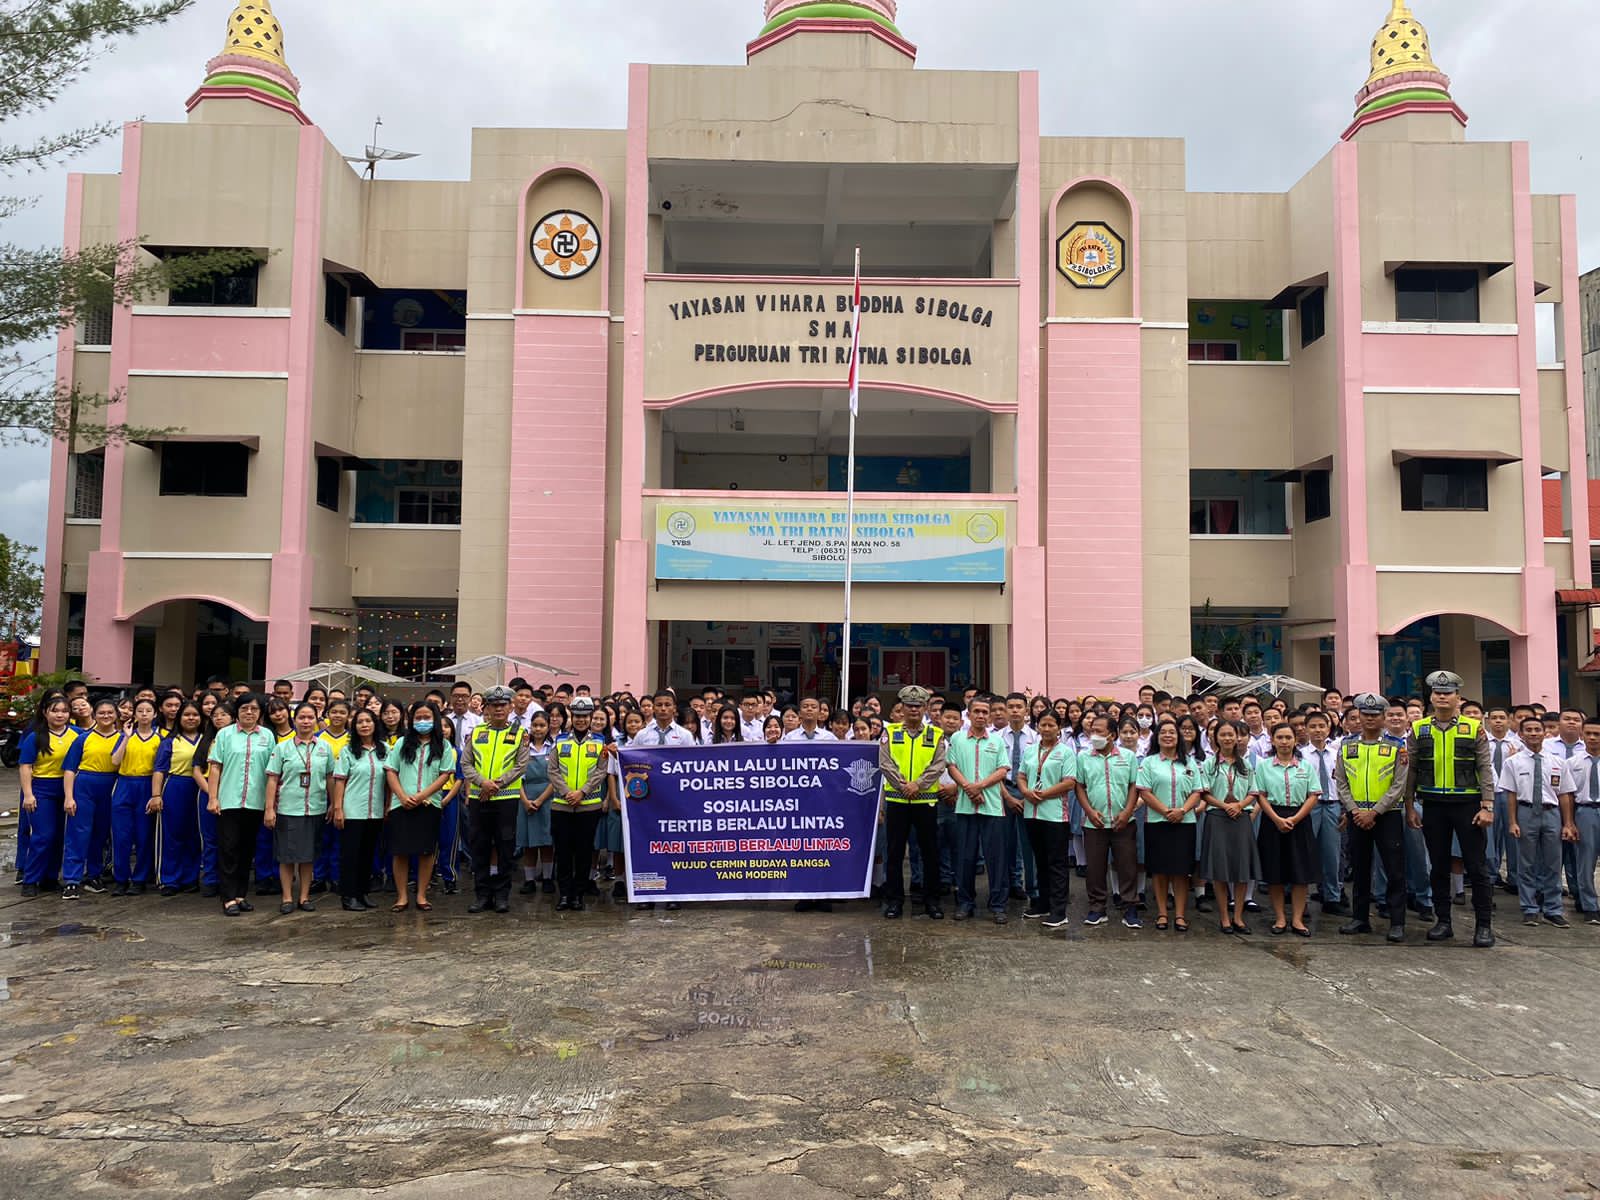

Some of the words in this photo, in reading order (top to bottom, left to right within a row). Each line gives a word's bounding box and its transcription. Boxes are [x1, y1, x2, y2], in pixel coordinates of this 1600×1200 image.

[1078, 265, 1106, 275] SIBOLGA
[669, 296, 745, 320] YAYASAN
[756, 294, 826, 312] VIHARA
[916, 297, 993, 328] SIBOLGA
[809, 320, 852, 338] SMA
[694, 344, 790, 362] PERGURUAN
[799, 346, 827, 363] TRI
[896, 348, 972, 365] SIBOLGA
[713, 512, 770, 523] YAYASAN
[774, 512, 826, 524] VIHARA
[892, 514, 951, 526] SIBOLGA
[749, 526, 774, 536] SMA
[780, 526, 803, 537] TRI
[856, 527, 915, 538] SIBOLGA
[662, 760, 729, 774] SATUAN
[734, 758, 778, 772] LALU
[782, 758, 840, 770] LINTAS
[680, 776, 744, 791] POLRES
[750, 775, 822, 789] SIBOLGA
[704, 798, 799, 814] SOSIALISASI
[658, 819, 712, 832] TERTIB
[716, 817, 787, 831] BERLALU
[792, 816, 844, 830] LINTAS
[650, 840, 684, 854] MARI
[688, 839, 736, 852] TERTIB
[740, 838, 801, 852] BERLALU
[804, 838, 850, 850] LINTAS
[672, 860, 708, 870] WUJUD
[710, 860, 746, 869] CERMIN
[750, 860, 788, 868] BUDAYA
[790, 859, 830, 868] BANGSA
[716, 871, 742, 880] YANG
[746, 870, 787, 880] MODERN
